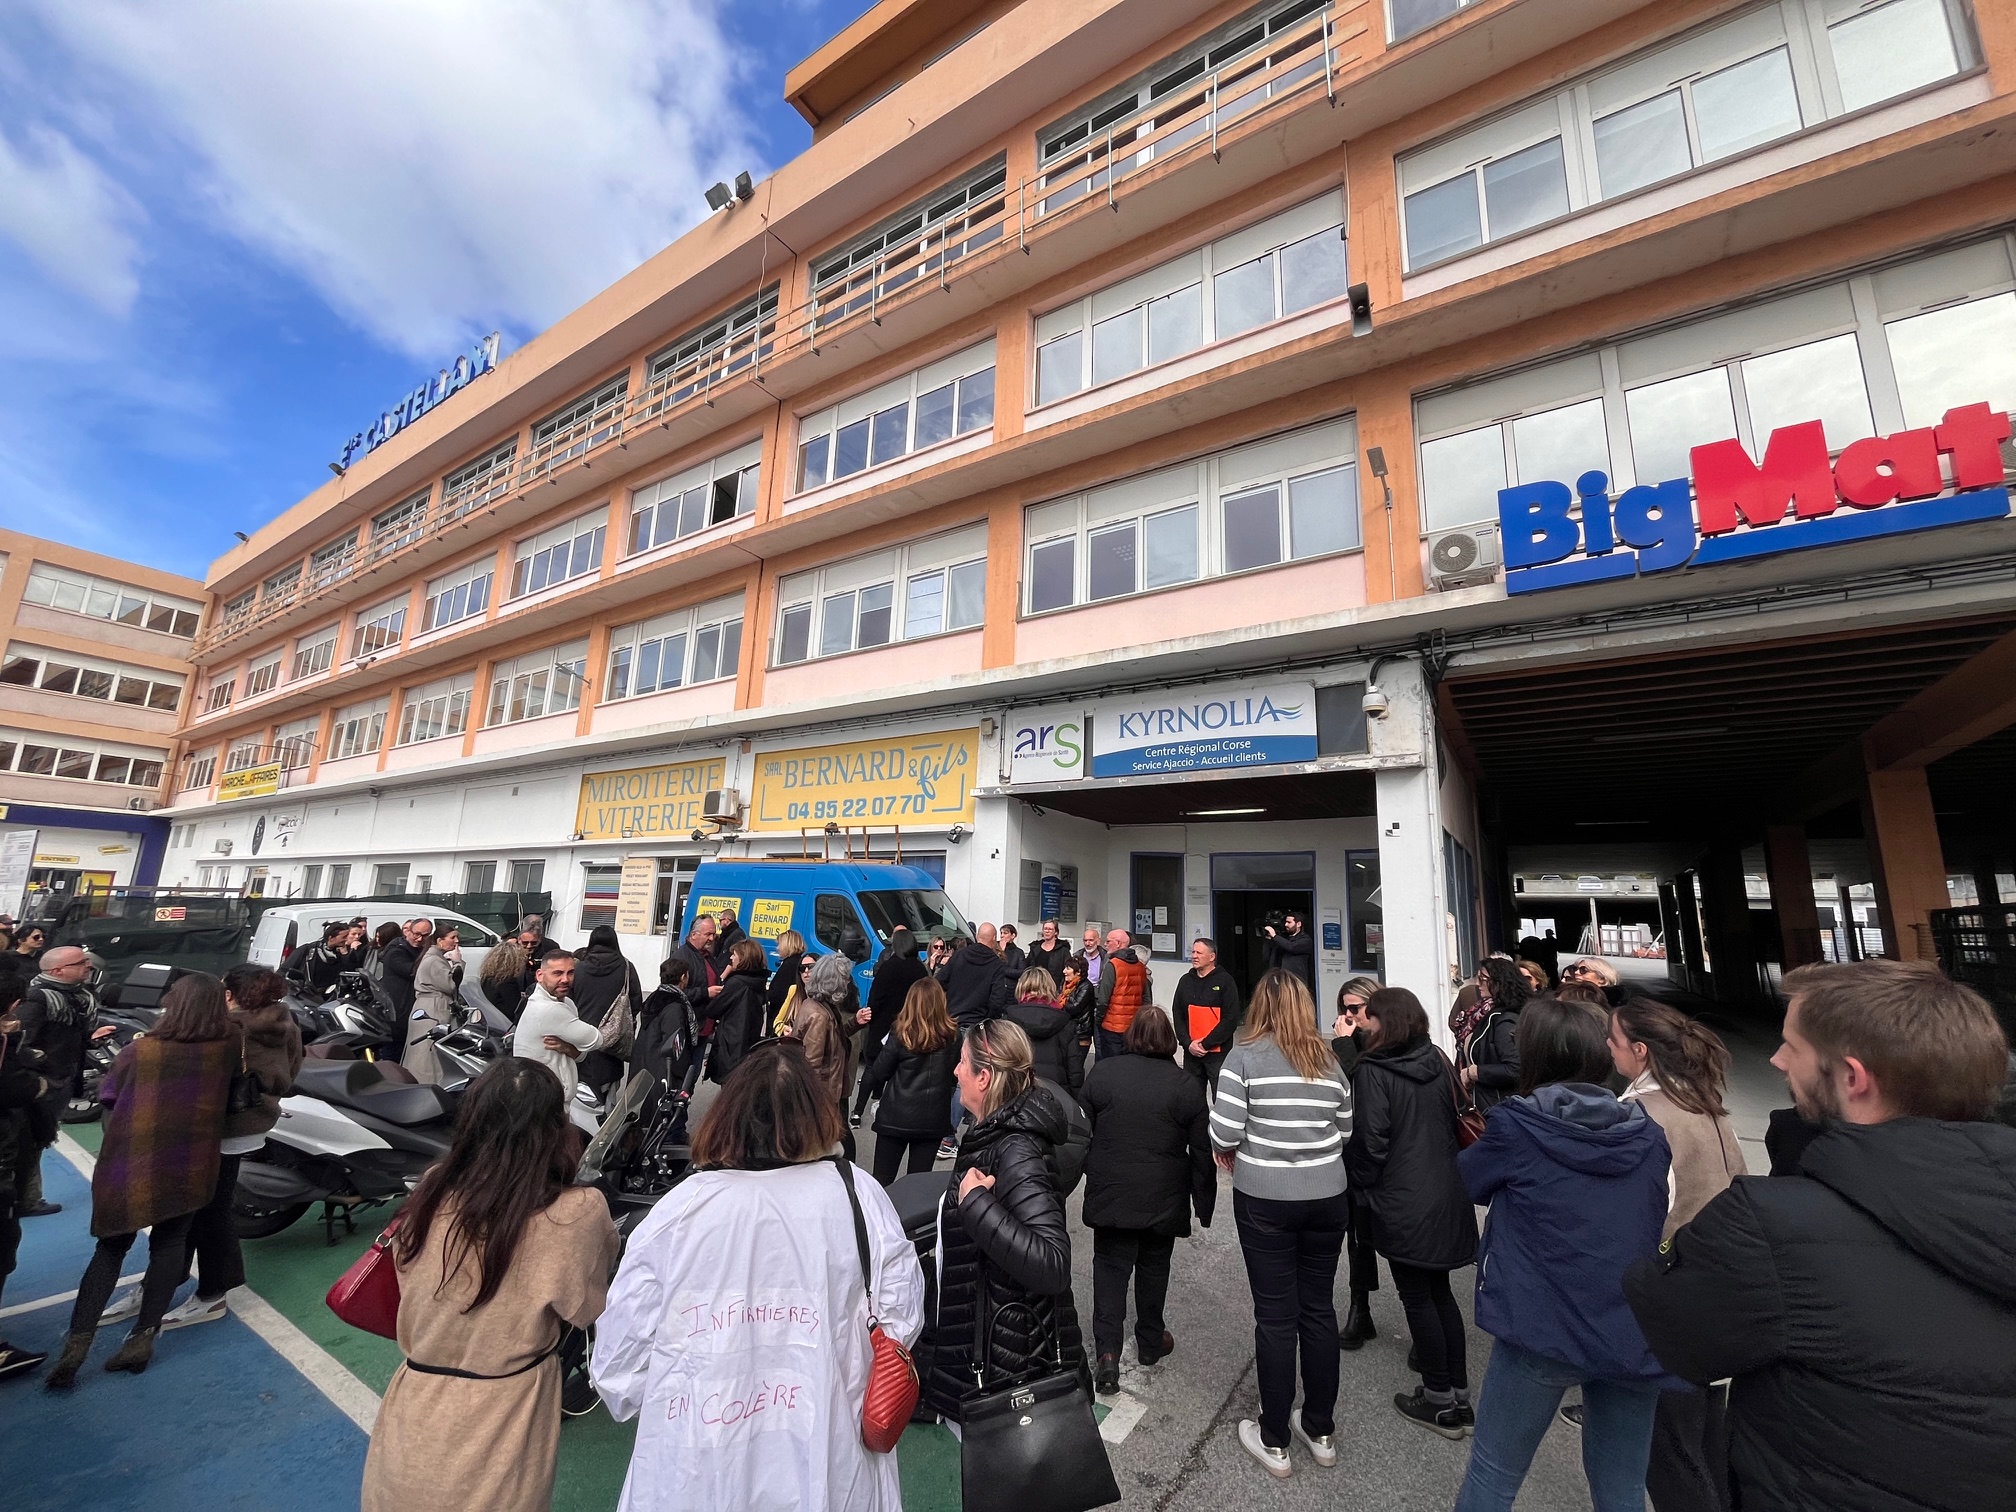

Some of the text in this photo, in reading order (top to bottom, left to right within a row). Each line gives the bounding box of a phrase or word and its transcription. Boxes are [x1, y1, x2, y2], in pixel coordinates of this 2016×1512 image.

[1498, 401, 2011, 574] BigMat
[1119, 695, 1281, 739] KYRNOLIA
[1132, 761, 1162, 771] Service
[1163, 758, 1194, 770] Ajaccio
[1201, 753, 1234, 765] Accueil
[1235, 751, 1267, 762] clients
[1145, 740, 1251, 758] Centre Régional Corse
[587, 764, 721, 804] MIROITERIE
[764, 743, 968, 800] SARL BERNARD & fils
[598, 801, 700, 834] VITRERIE
[787, 794, 926, 821] 04.95.22.07.70
[702, 898, 738, 909] MIROITERIE
[765, 902, 780, 912] Sarl
[754, 913, 789, 925] BERNARD
[758, 926, 781, 937] & FILS
[667, 1380, 802, 1425] EN COLÈRE
